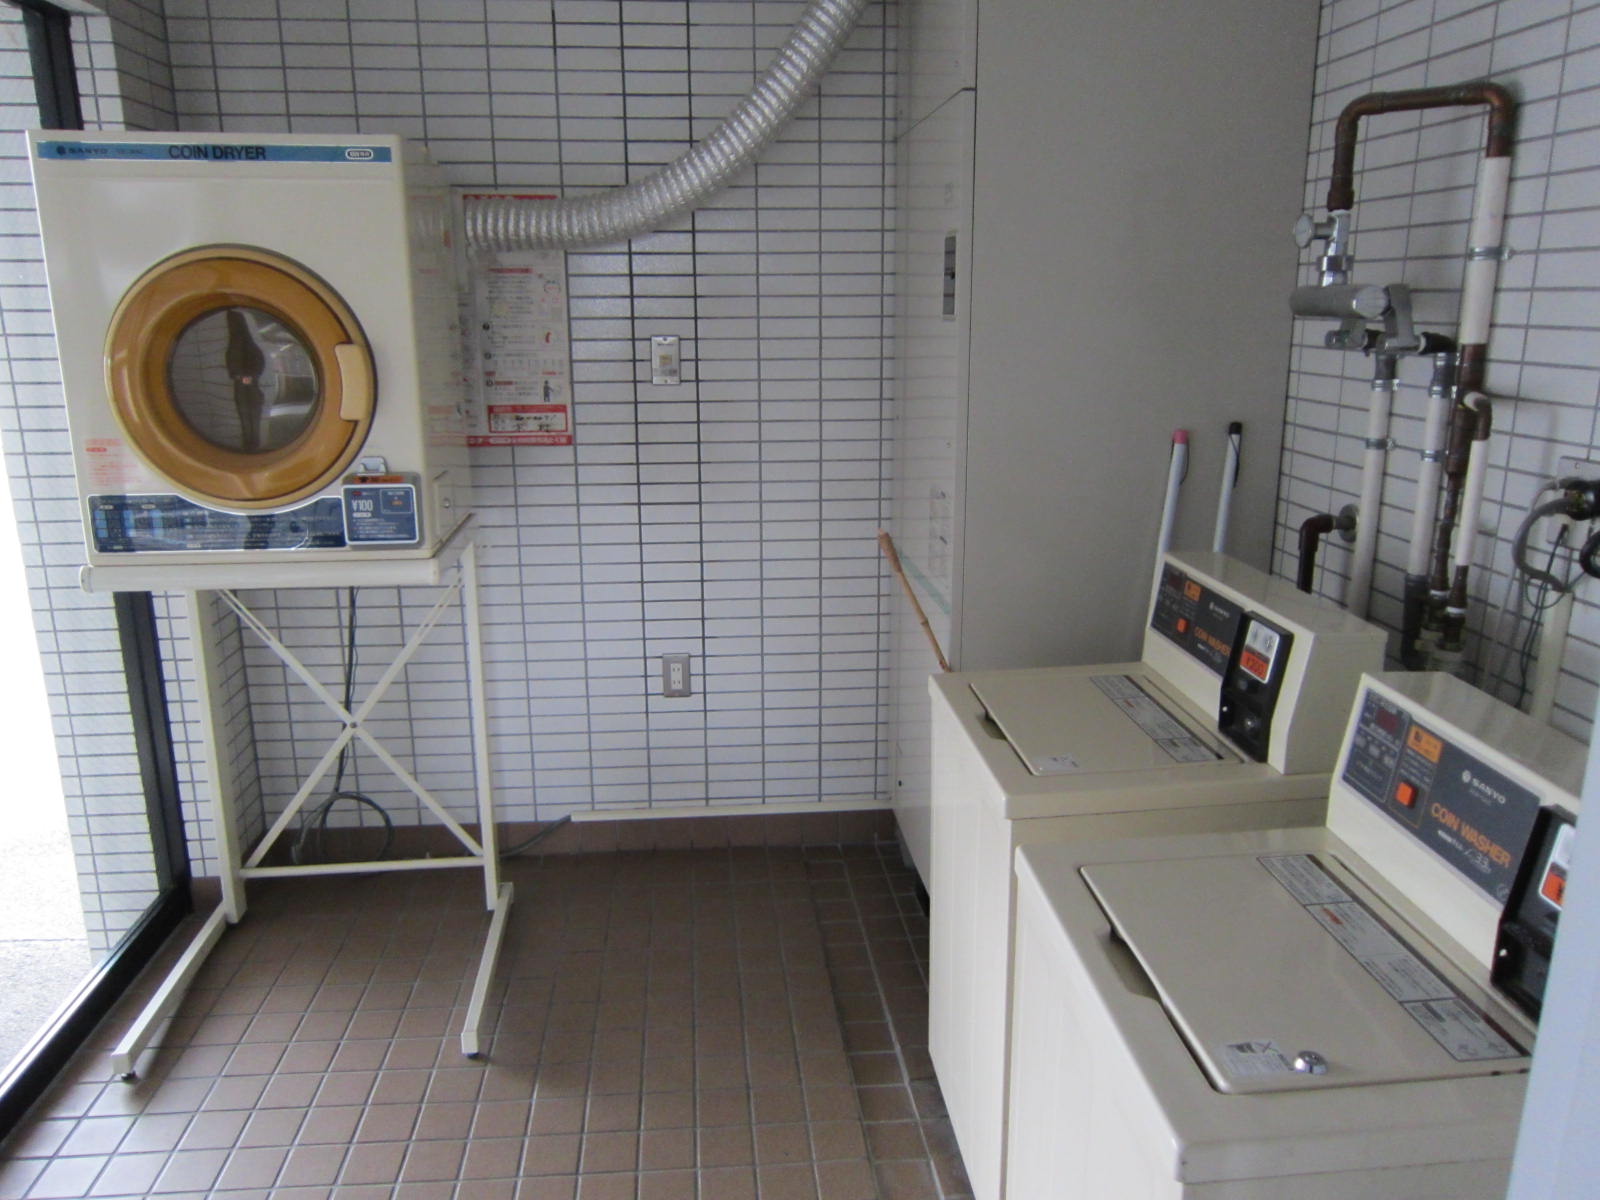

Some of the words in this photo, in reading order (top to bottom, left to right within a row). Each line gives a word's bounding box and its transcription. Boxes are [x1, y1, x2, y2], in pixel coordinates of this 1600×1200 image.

[168, 144, 209, 160] COIN
[211, 144, 267, 161] DRYER
[1472, 778, 1506, 805] SANYO
[1431, 802, 1461, 831] COIN
[1460, 821, 1511, 869] WASHER
